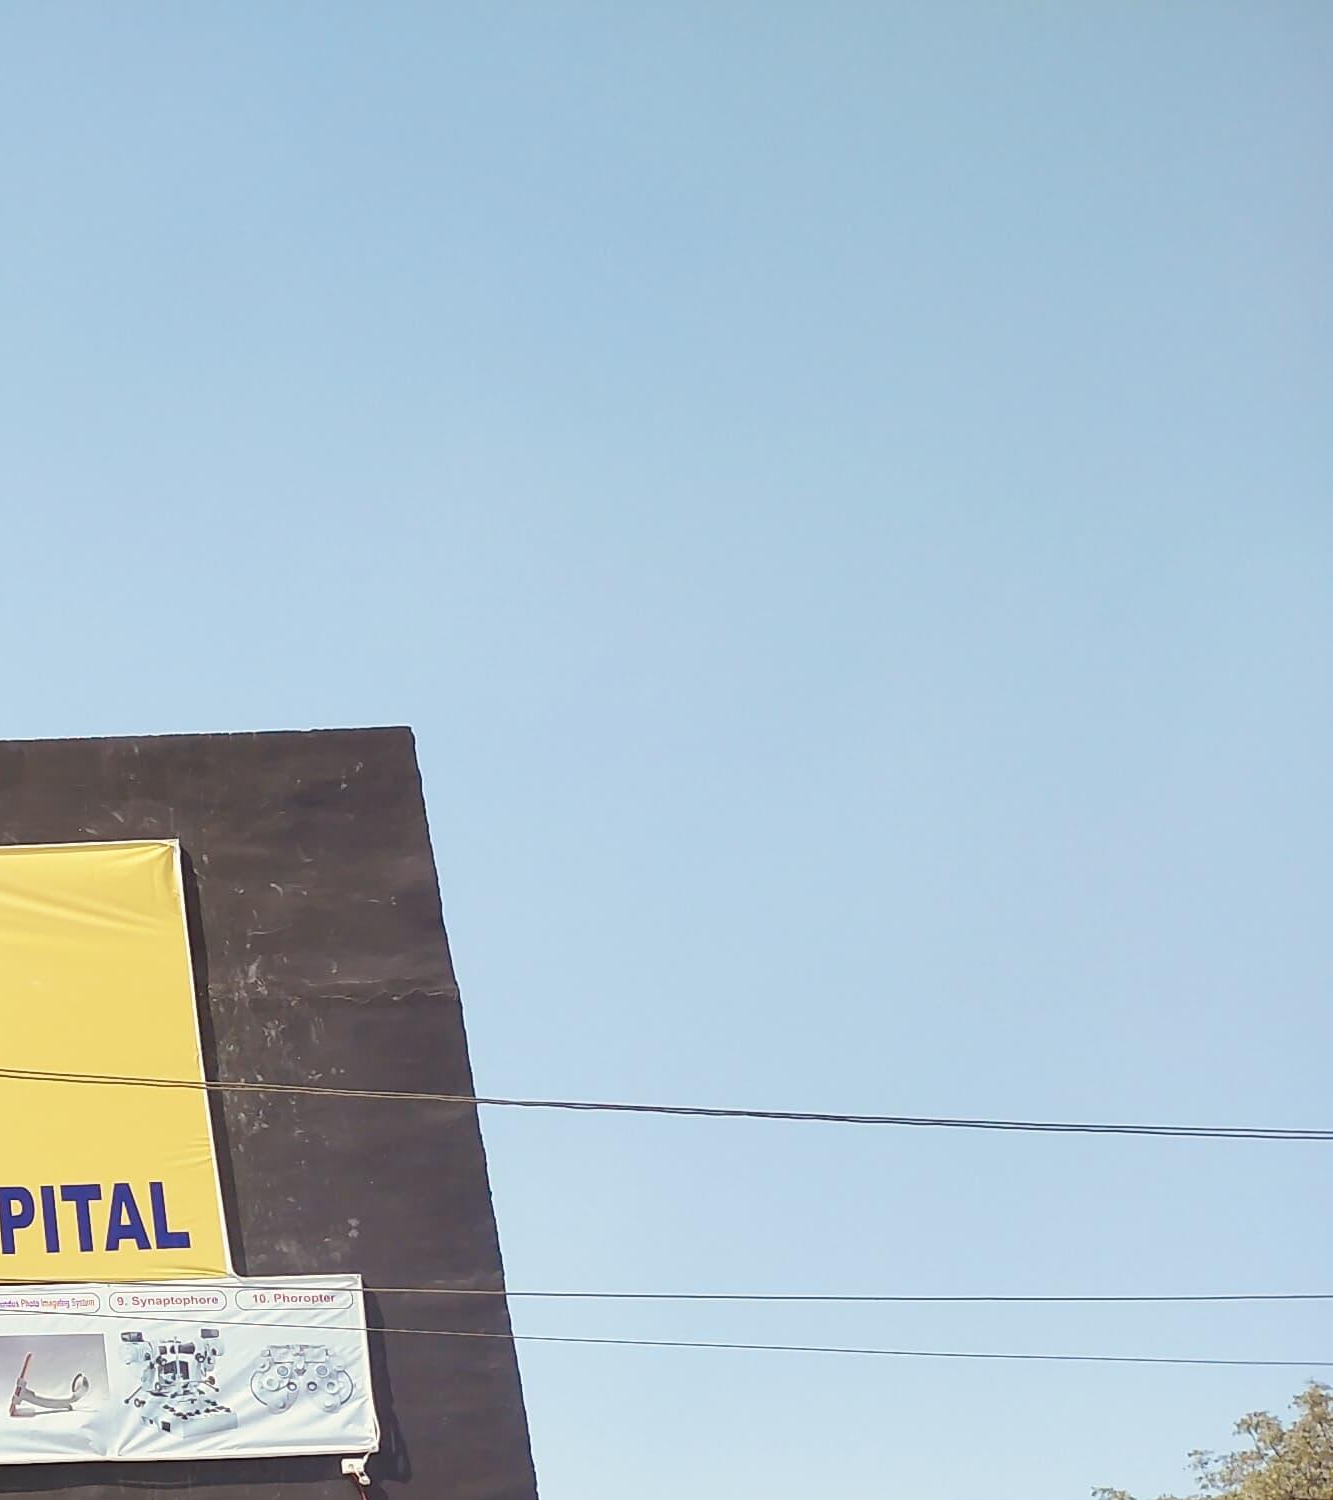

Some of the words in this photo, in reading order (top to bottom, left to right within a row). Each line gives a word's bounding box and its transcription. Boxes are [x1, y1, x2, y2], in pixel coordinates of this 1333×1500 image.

[117, 1297, 127, 1306] 9.
[131, 1295, 218, 1306] Synaptophore
[253, 1294, 270, 1304] 10.
[274, 1293, 335, 1303] Phoropter
